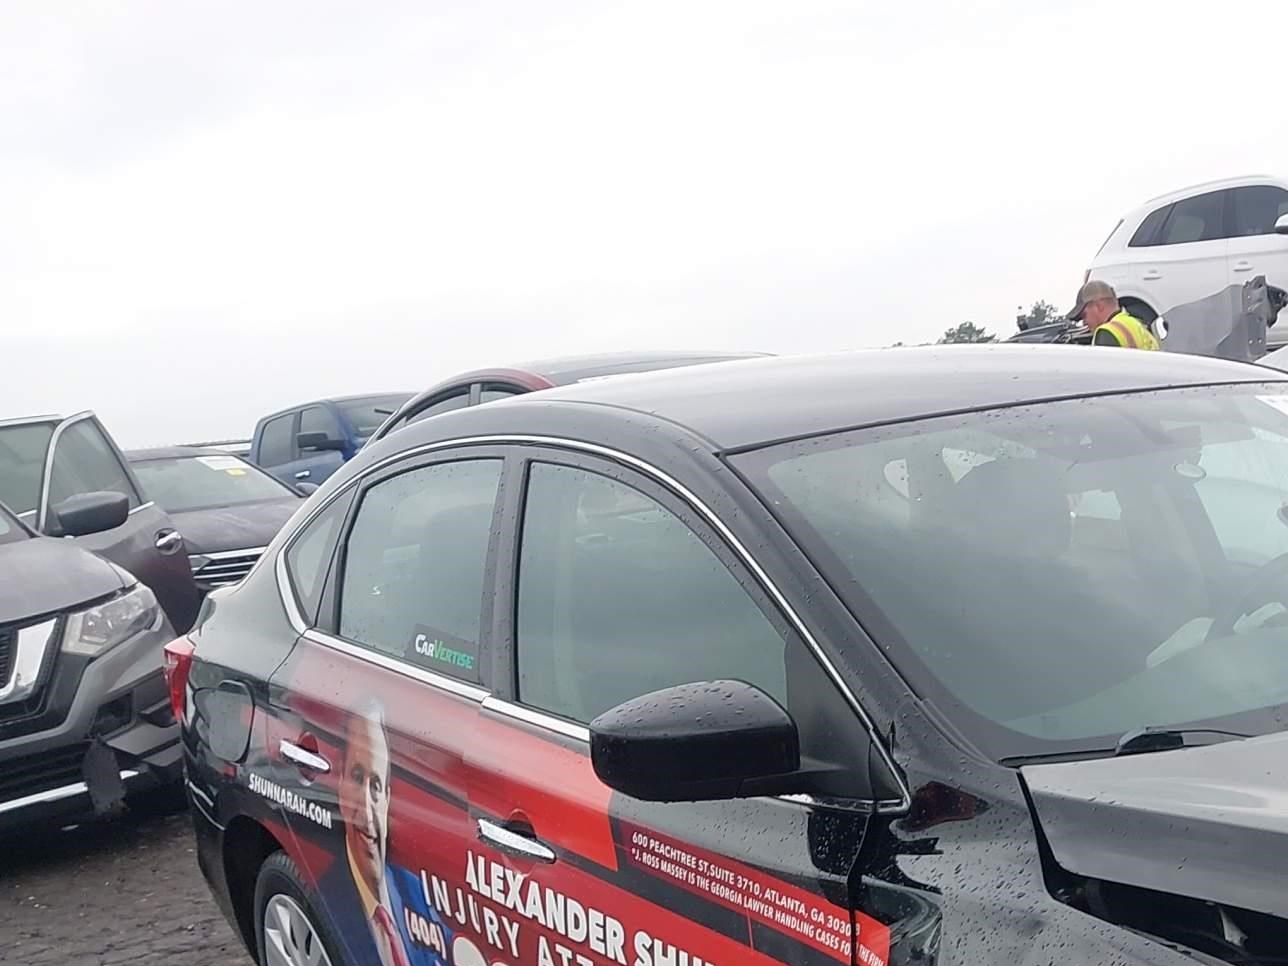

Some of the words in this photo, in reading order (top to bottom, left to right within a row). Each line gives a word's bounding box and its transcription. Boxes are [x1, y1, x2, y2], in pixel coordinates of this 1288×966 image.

[248, 773, 332, 829] SHUNNARAH.COM
[420, 869, 520, 958] INJURY
[465, 850, 628, 966] ALEXANDER
[632, 832, 648, 847] 600
[649, 839, 697, 869] PEACHTREE
[736, 876, 764, 897] 3710,
[764, 888, 809, 918] ATLANTA,
[811, 908, 825, 924] GA
[642, 852, 660, 869] ROSS
[660, 860, 687, 881] MASSEY
[688, 872, 696, 884] IS
[696, 875, 710, 891] THE
[711, 882, 742, 905] GEORGIA
[743, 895, 774, 919] LAWYER
[775, 910, 815, 938] HANDLING
[815, 928, 840, 950] CASES
[404, 907, 447, 961] (404)
